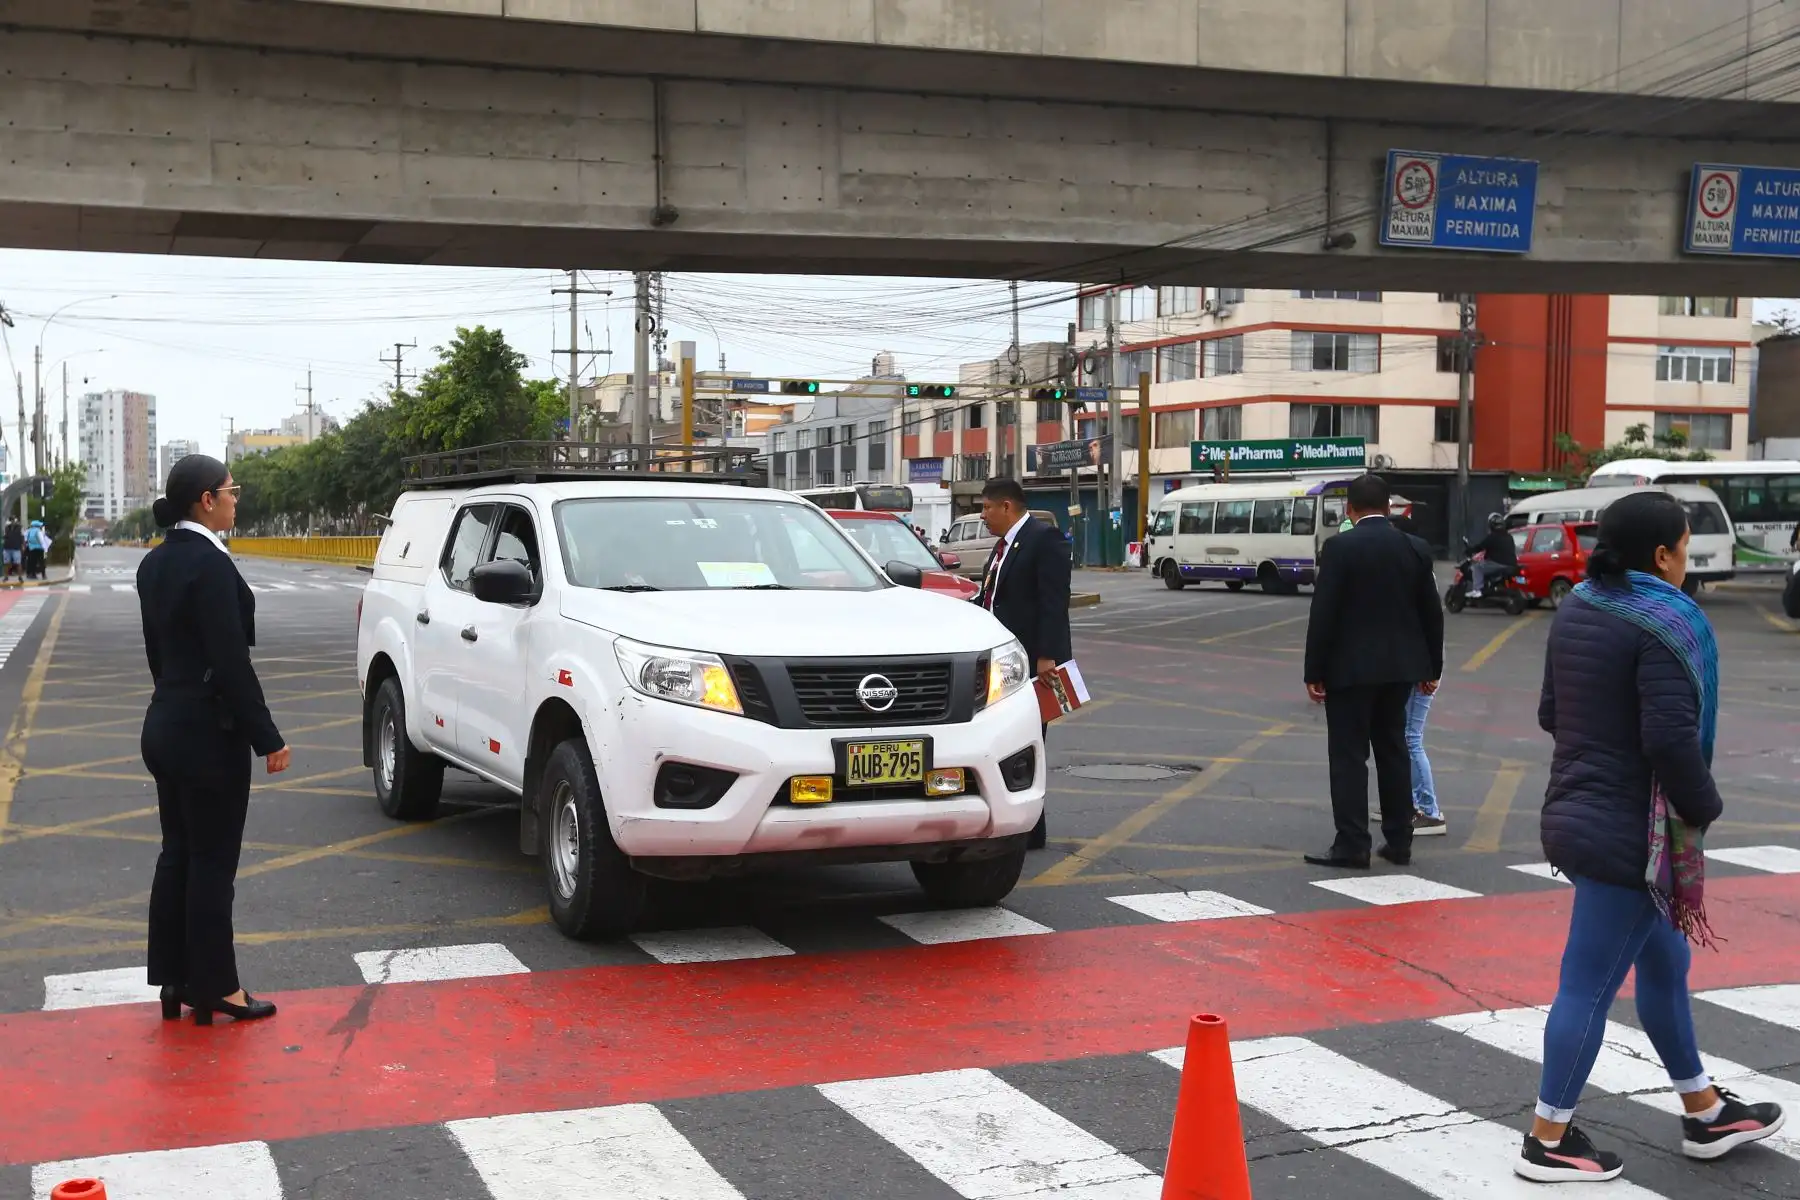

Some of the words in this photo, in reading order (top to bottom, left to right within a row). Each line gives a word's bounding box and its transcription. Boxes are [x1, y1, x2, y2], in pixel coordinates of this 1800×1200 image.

[1457, 169, 1519, 187] ALTURA
[1754, 180, 1800, 196] ALTUR
[1454, 194, 1517, 212] MAXIMA
[1392, 212, 1431, 223] ALTURA
[1752, 204, 1800, 220] MAXIM
[1391, 224, 1430, 236] MAXIMA
[1446, 219, 1520, 238] PERMITIDA
[1696, 220, 1730, 232] ALTURA
[1695, 233, 1729, 244] MAXIMA
[1744, 227, 1800, 244] PERMITID
[873, 743, 900, 753] PERU
[851, 752, 920, 778] AUB-795
